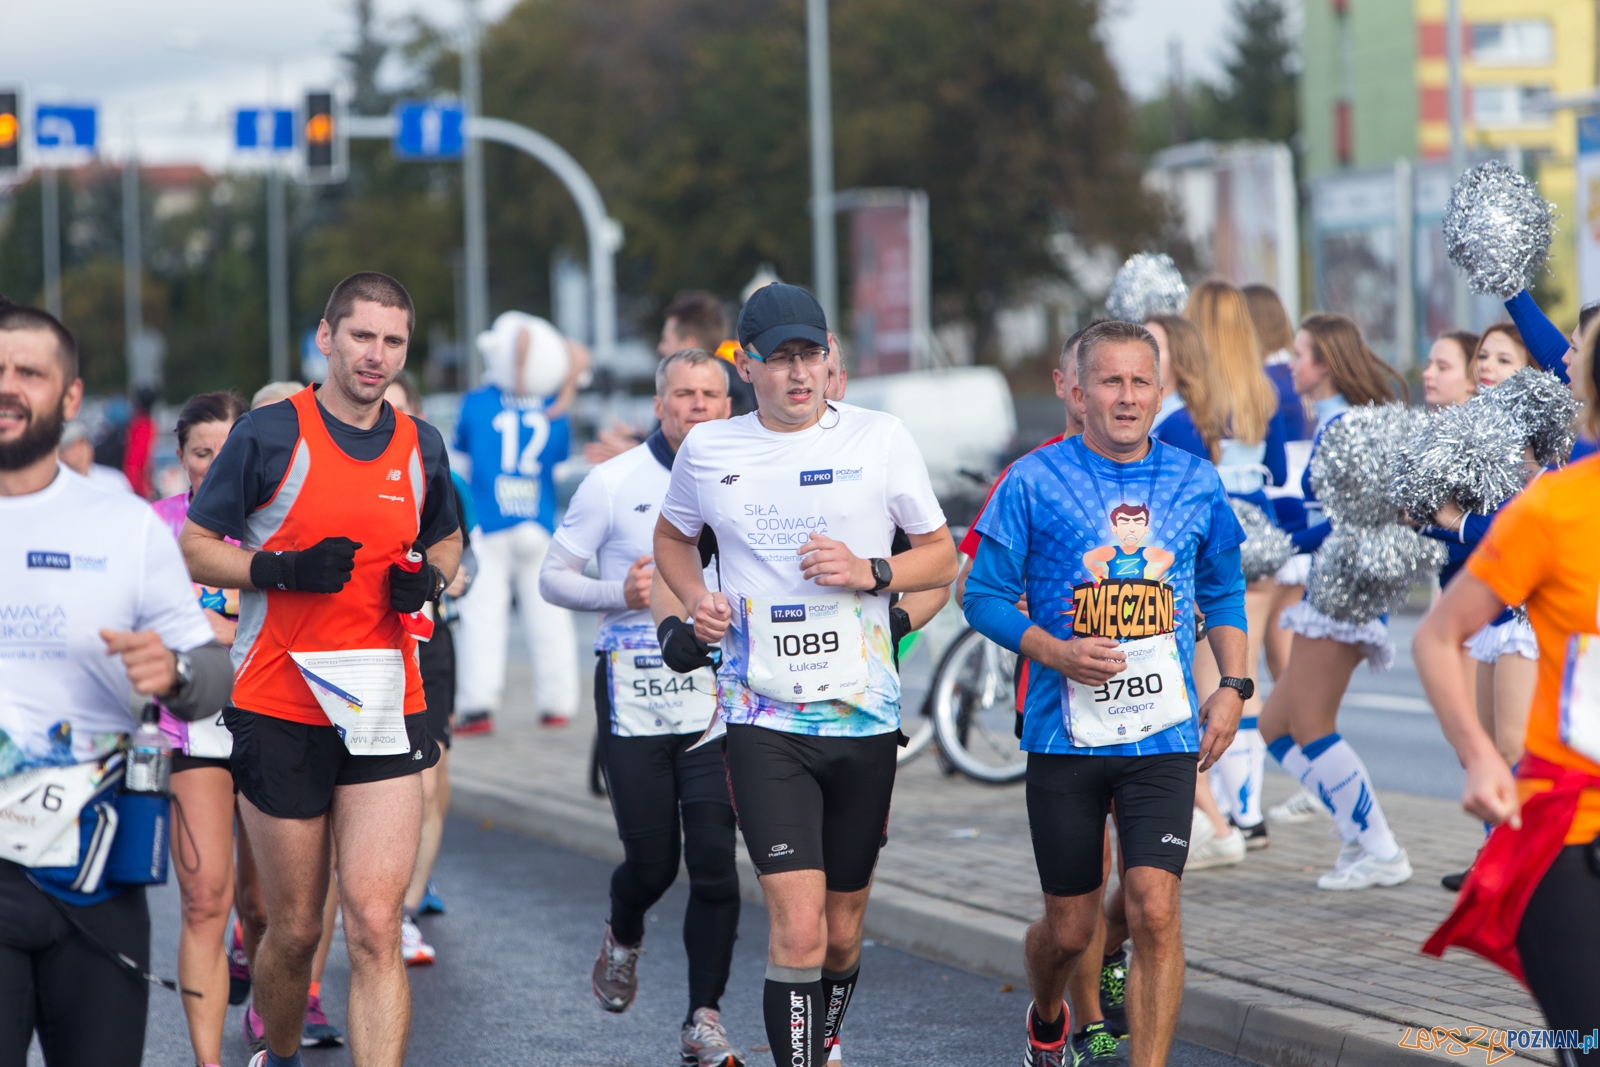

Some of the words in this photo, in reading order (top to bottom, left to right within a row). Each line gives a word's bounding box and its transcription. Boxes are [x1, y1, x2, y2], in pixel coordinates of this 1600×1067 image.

[491, 409, 551, 477] 12
[721, 475, 740, 485] 4F
[814, 473, 831, 481] PKO
[634, 504, 651, 512] 4F
[744, 504, 779, 516] SIŁA
[756, 516, 827, 530] ODWAGA
[748, 529, 828, 544] SZYBKO
[785, 609, 803, 617] PKO
[773, 631, 839, 657] 1089
[789, 662, 829, 672] Łukasz
[634, 676, 694, 697] 5644
[1094, 673, 1163, 702] 3780
[1108, 702, 1155, 715] Grzegorz
[1171, 837, 1188, 847] asics
[768, 848, 794, 858] Kalenji
